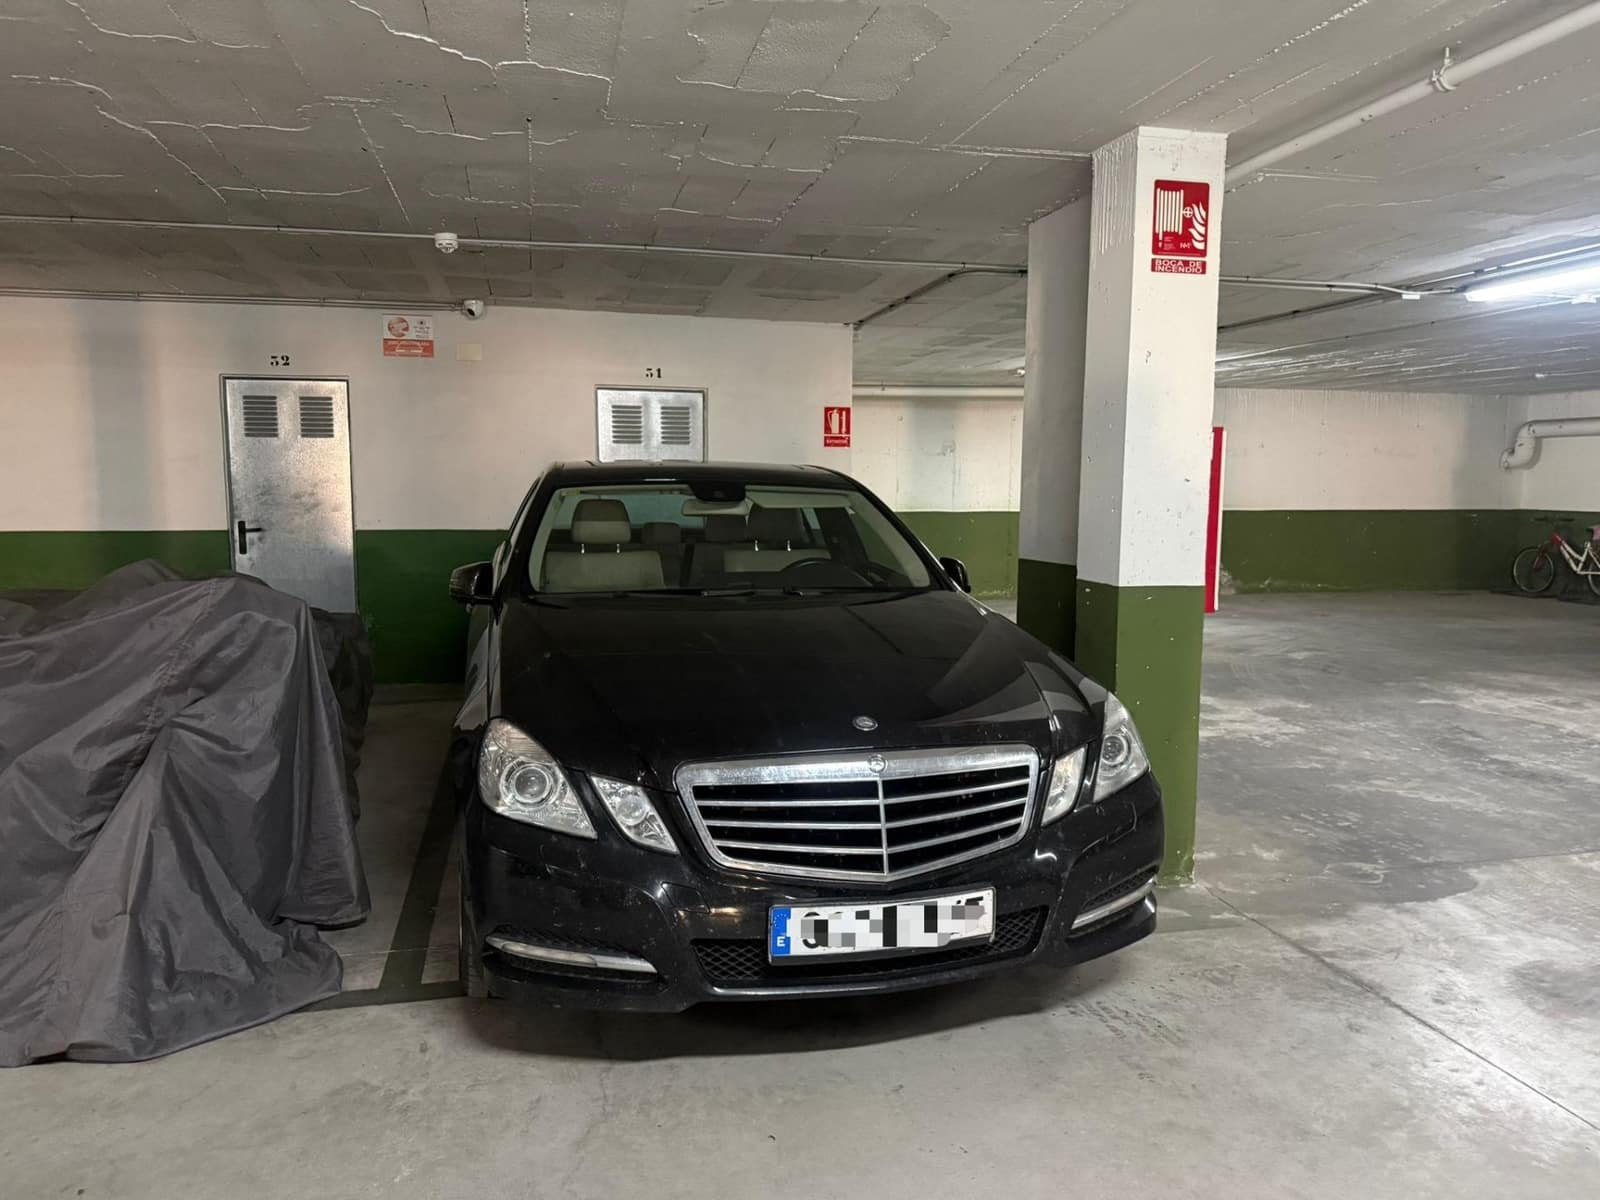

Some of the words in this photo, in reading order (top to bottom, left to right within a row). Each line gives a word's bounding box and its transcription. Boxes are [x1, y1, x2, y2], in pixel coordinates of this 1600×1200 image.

[1154, 258, 1184, 266] BOCA
[1188, 260, 1202, 268] DE
[1154, 265, 1203, 273] INCENDIO
[270, 355, 290, 367] 52
[776, 936, 785, 947] E
